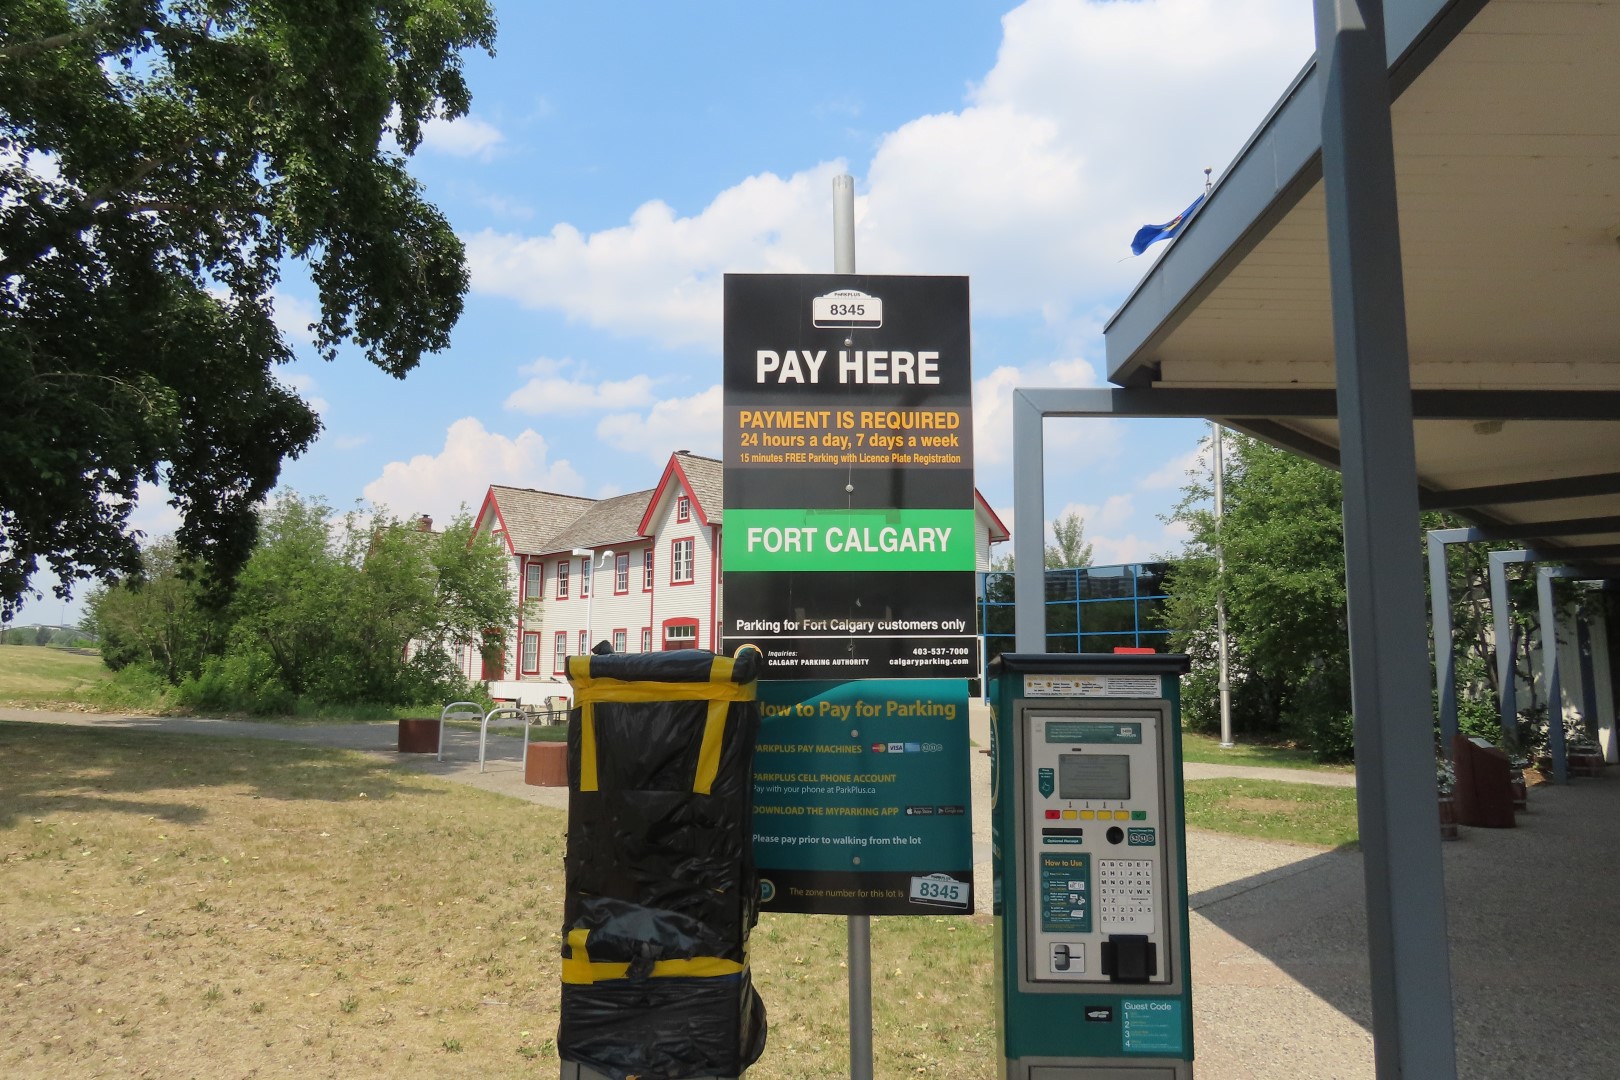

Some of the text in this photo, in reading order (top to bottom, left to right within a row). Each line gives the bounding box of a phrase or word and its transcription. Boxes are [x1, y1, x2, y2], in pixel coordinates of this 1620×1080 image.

[830, 304, 865, 316] 8345
[756, 350, 940, 385] PAY HERE
[739, 411, 960, 430] PAYMENT IS REQUIRED
[740, 432, 959, 451] 24 hours a day, 7 days a week
[740, 453, 961, 466] 15 minutes FREE Parking with Licence Plate Registration
[747, 527, 952, 553] FORT CALGARY
[736, 618, 966, 634] Parking for Fort Calgary customers only
[767, 650, 799, 658] Inquiries:
[912, 647, 969, 656] 403-537-7000
[832, 658, 870, 666] AUTHORITY
[889, 657, 969, 667] calgaryparking.com
[795, 702, 815, 718] to
[819, 701, 851, 721] Pay
[855, 700, 882, 717] for
[886, 700, 957, 721] Parking
[797, 745, 815, 753] PAY
[815, 745, 863, 754] MACHINES
[797, 773, 819, 782] CELL
[820, 774, 852, 783] PHONE
[853, 774, 897, 783] ACCOUNT
[766, 785, 782, 793] with
[801, 785, 825, 795] phone
[826, 786, 834, 794] at
[835, 786, 876, 794] ParkPlus.ca
[753, 806, 899, 816] DOWNLOAD THE MYPARKING APP
[752, 834, 921, 846] Please pay prior to walking from the lot
[1045, 859, 1060, 867] How
[1070, 859, 1083, 867] Use
[789, 887, 804, 896] The
[825, 888, 856, 898] number
[857, 889, 869, 898] for
[870, 889, 884, 898] this
[885, 889, 896, 898] lot
[920, 882, 959, 900] 8345
[1124, 1002, 1172, 1011] Guest Code
[1124, 1020, 1130, 1029] 2
[1124, 1030, 1130, 1038] 3
[1125, 1040, 1130, 1048] 4
